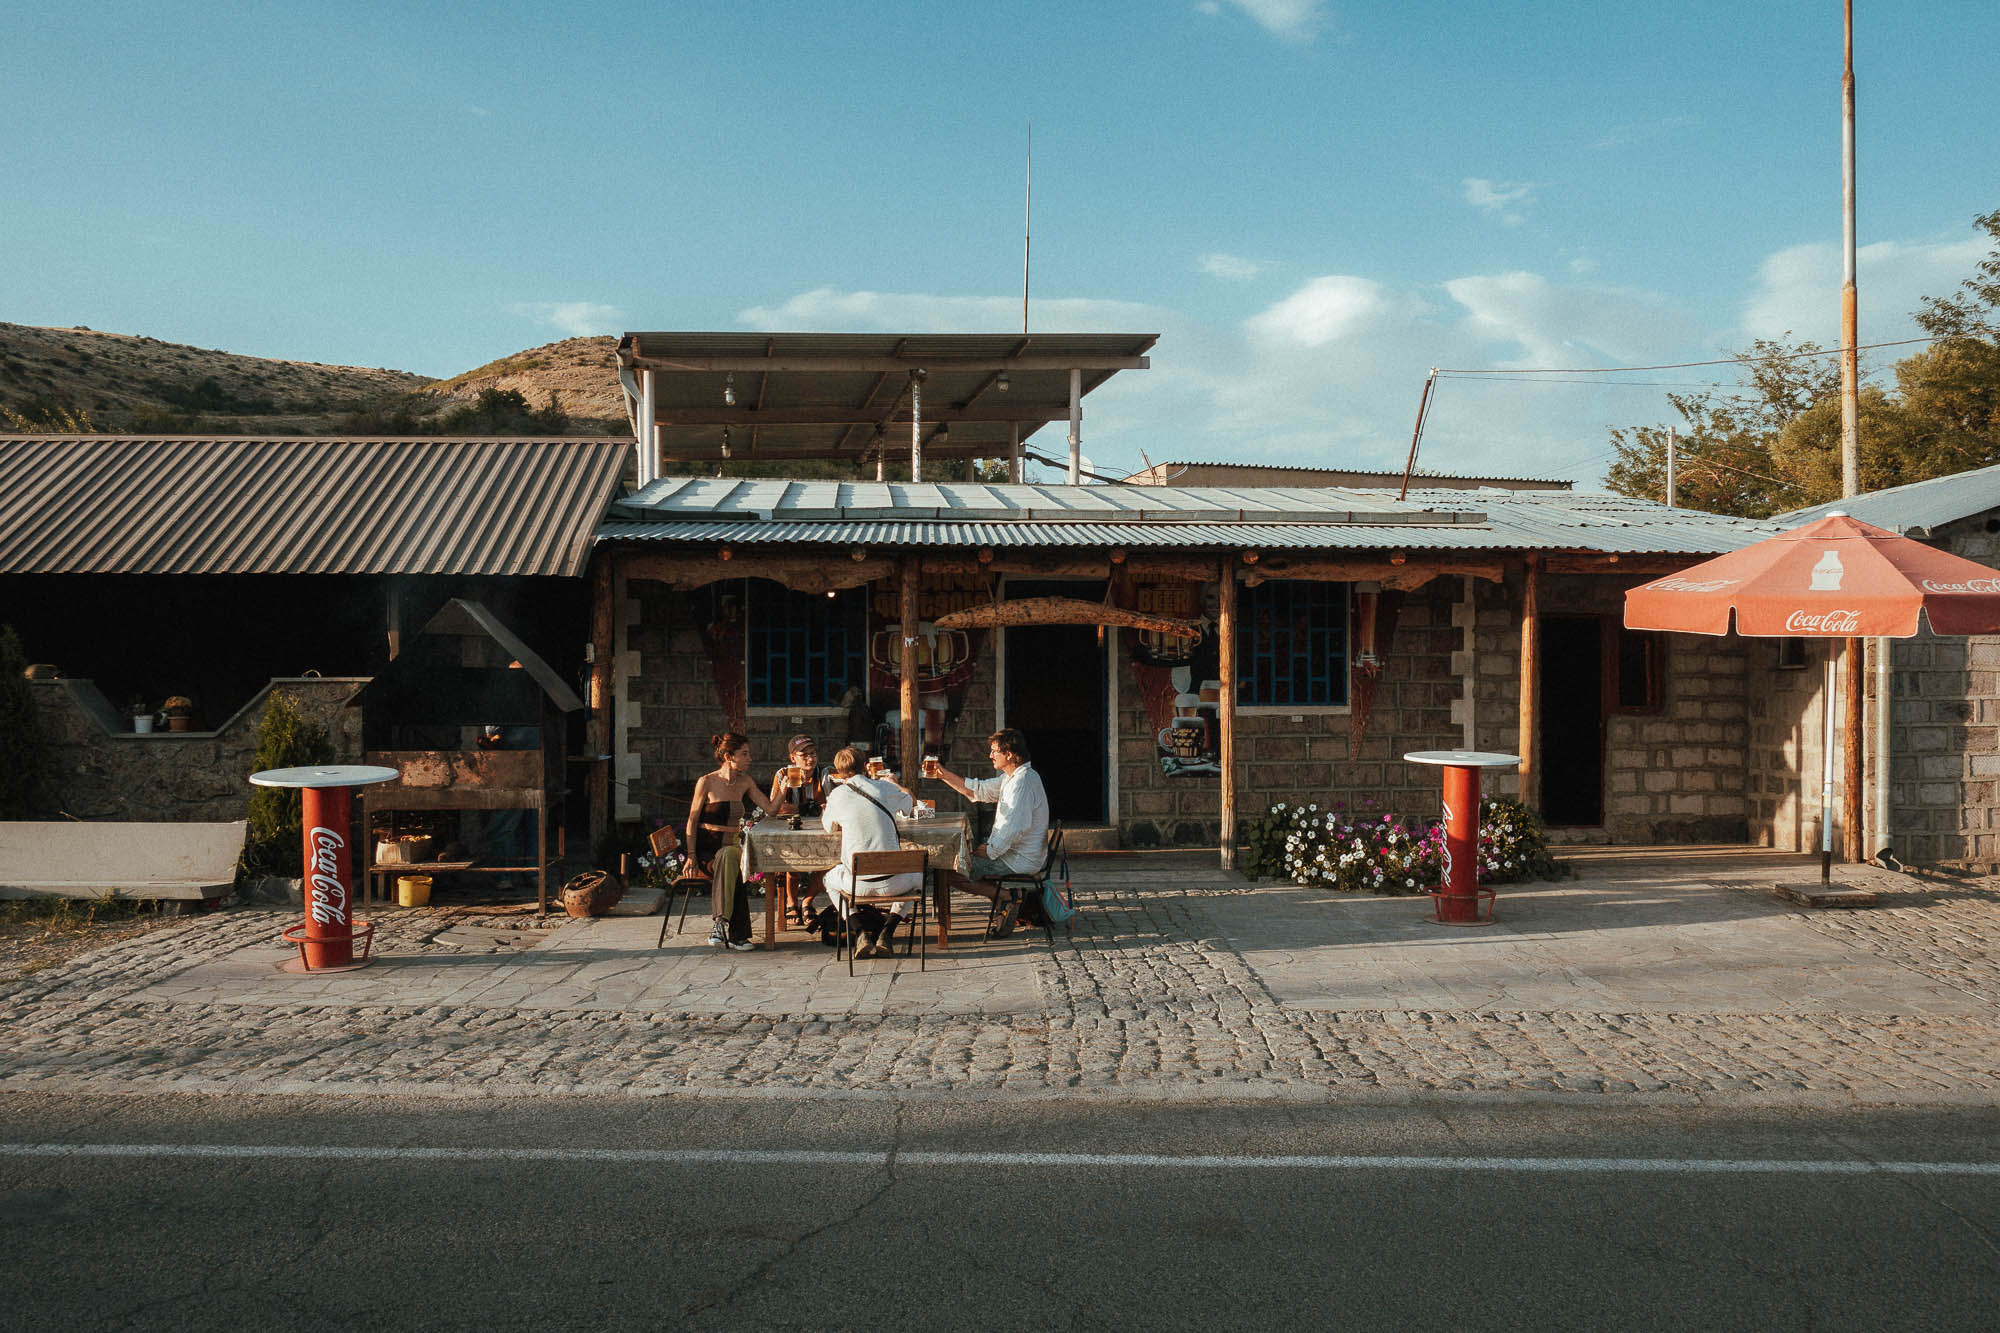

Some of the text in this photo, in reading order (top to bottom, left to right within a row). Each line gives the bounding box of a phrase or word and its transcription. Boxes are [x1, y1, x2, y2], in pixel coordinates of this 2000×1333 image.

[1922, 578, 2000, 593] Coca-Col
[1785, 609, 1863, 632] Coca-Cola
[310, 827, 345, 926] Coca-Cola
